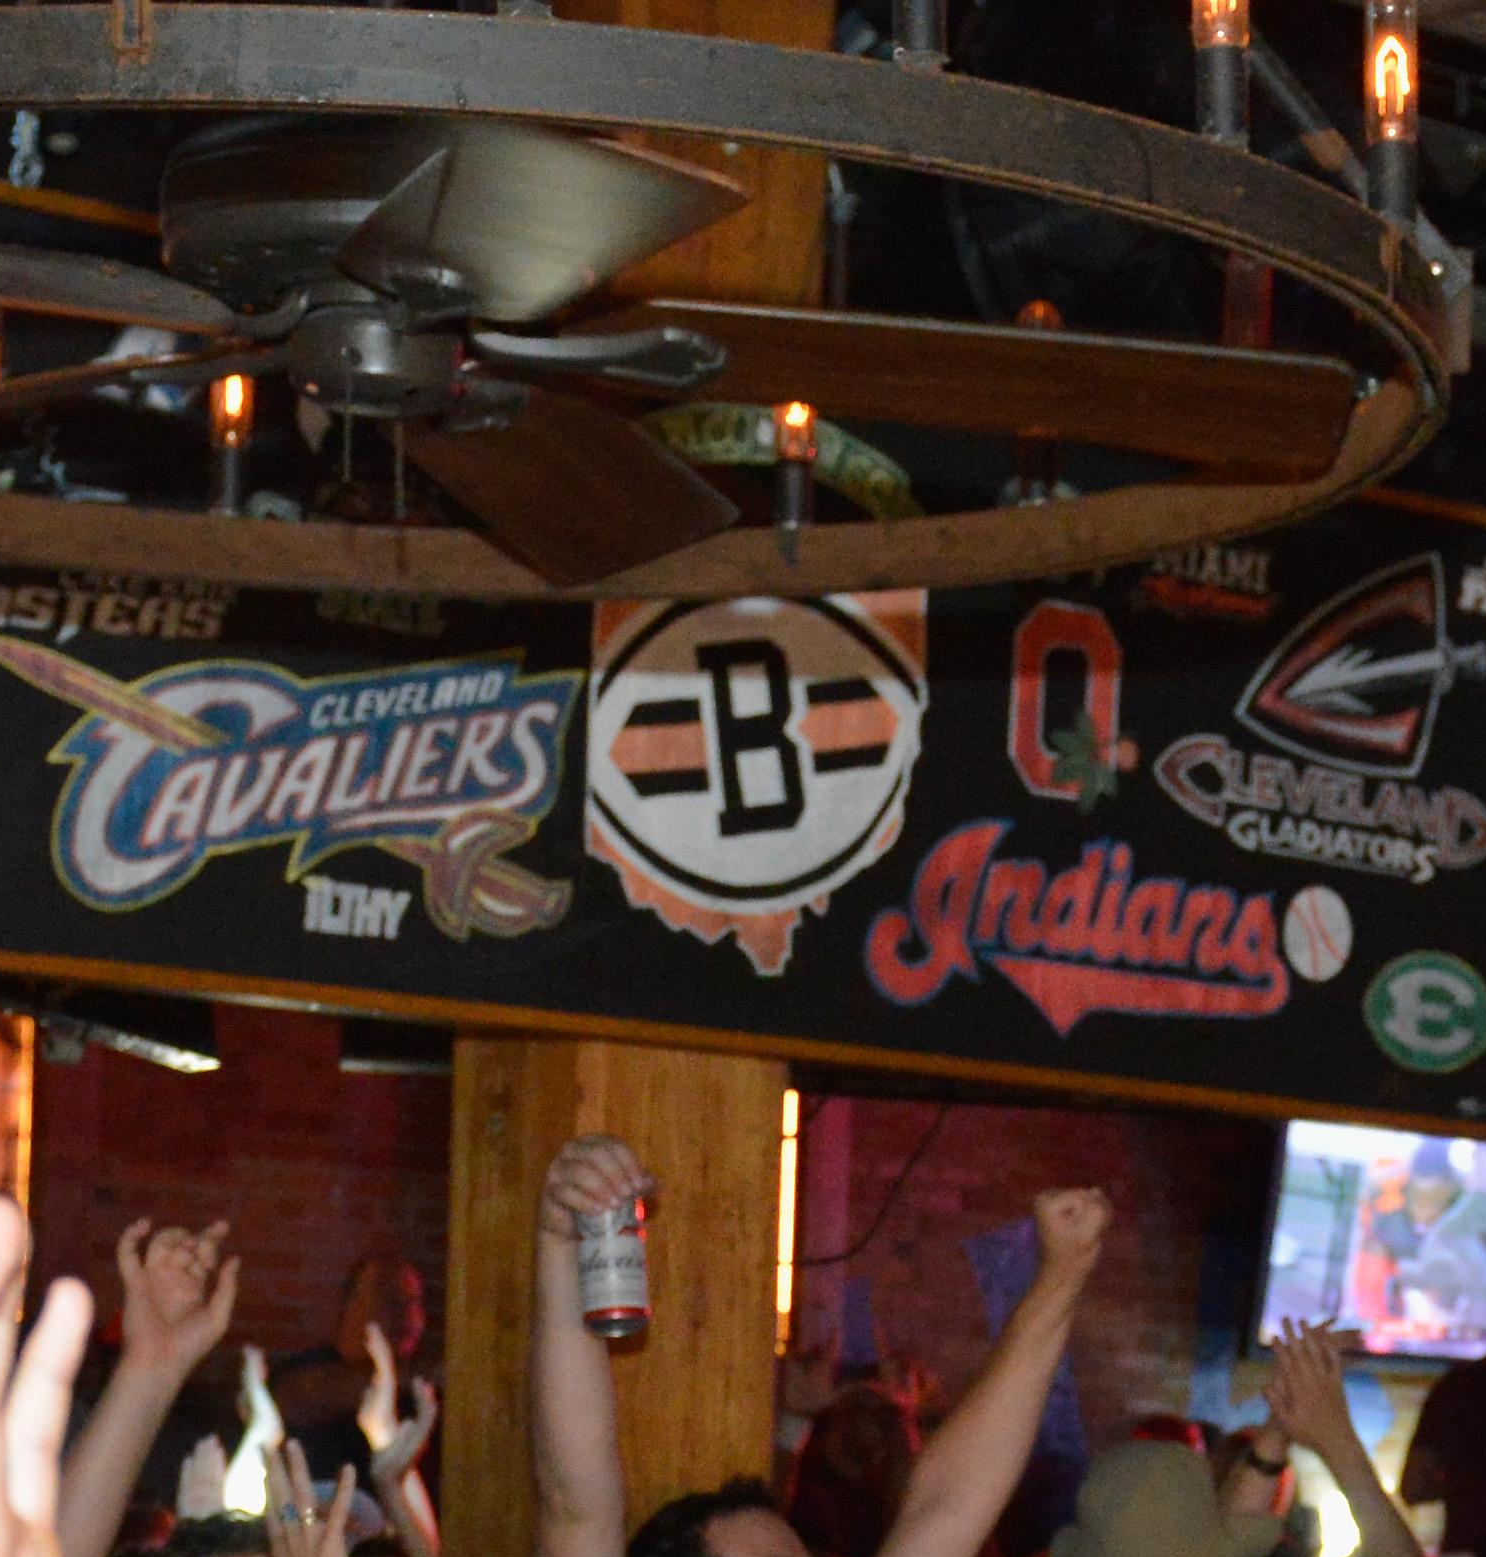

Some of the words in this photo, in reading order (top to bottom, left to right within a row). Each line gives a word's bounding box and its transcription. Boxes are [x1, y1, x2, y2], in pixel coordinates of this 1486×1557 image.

[309, 668, 503, 730] CLEVELAND
[695, 638, 804, 837] B
[74, 678, 560, 895] CAVALIERS
[1227, 811, 1437, 884] GLADIATORS
[866, 820, 1291, 1020] Indians
[1380, 966, 1480, 1055] E
